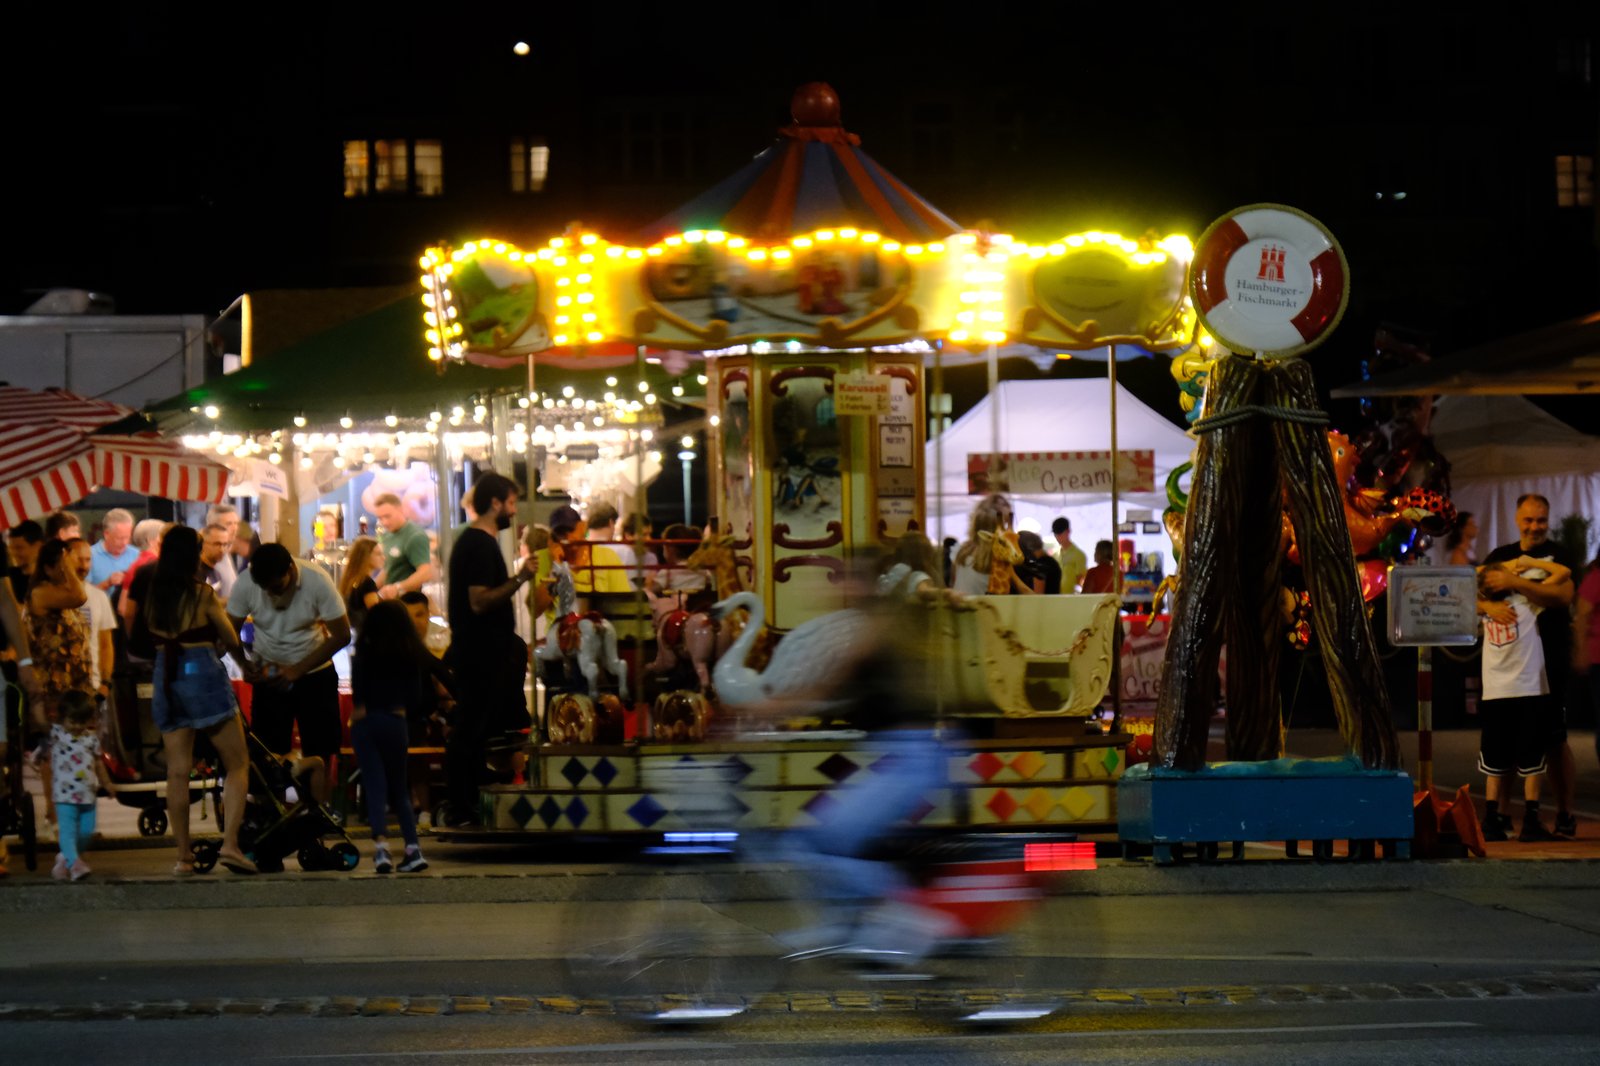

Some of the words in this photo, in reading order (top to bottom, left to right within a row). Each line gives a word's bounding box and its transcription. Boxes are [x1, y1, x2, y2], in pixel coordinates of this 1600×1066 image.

[1238, 292, 1297, 308] Fischmarkt
[838, 383, 887, 393] Karussell
[1011, 462, 1041, 483] Ice
[1041, 468, 1111, 493] Cream
[1486, 621, 1516, 644] NFL
[1125, 676, 1160, 698] Cre
